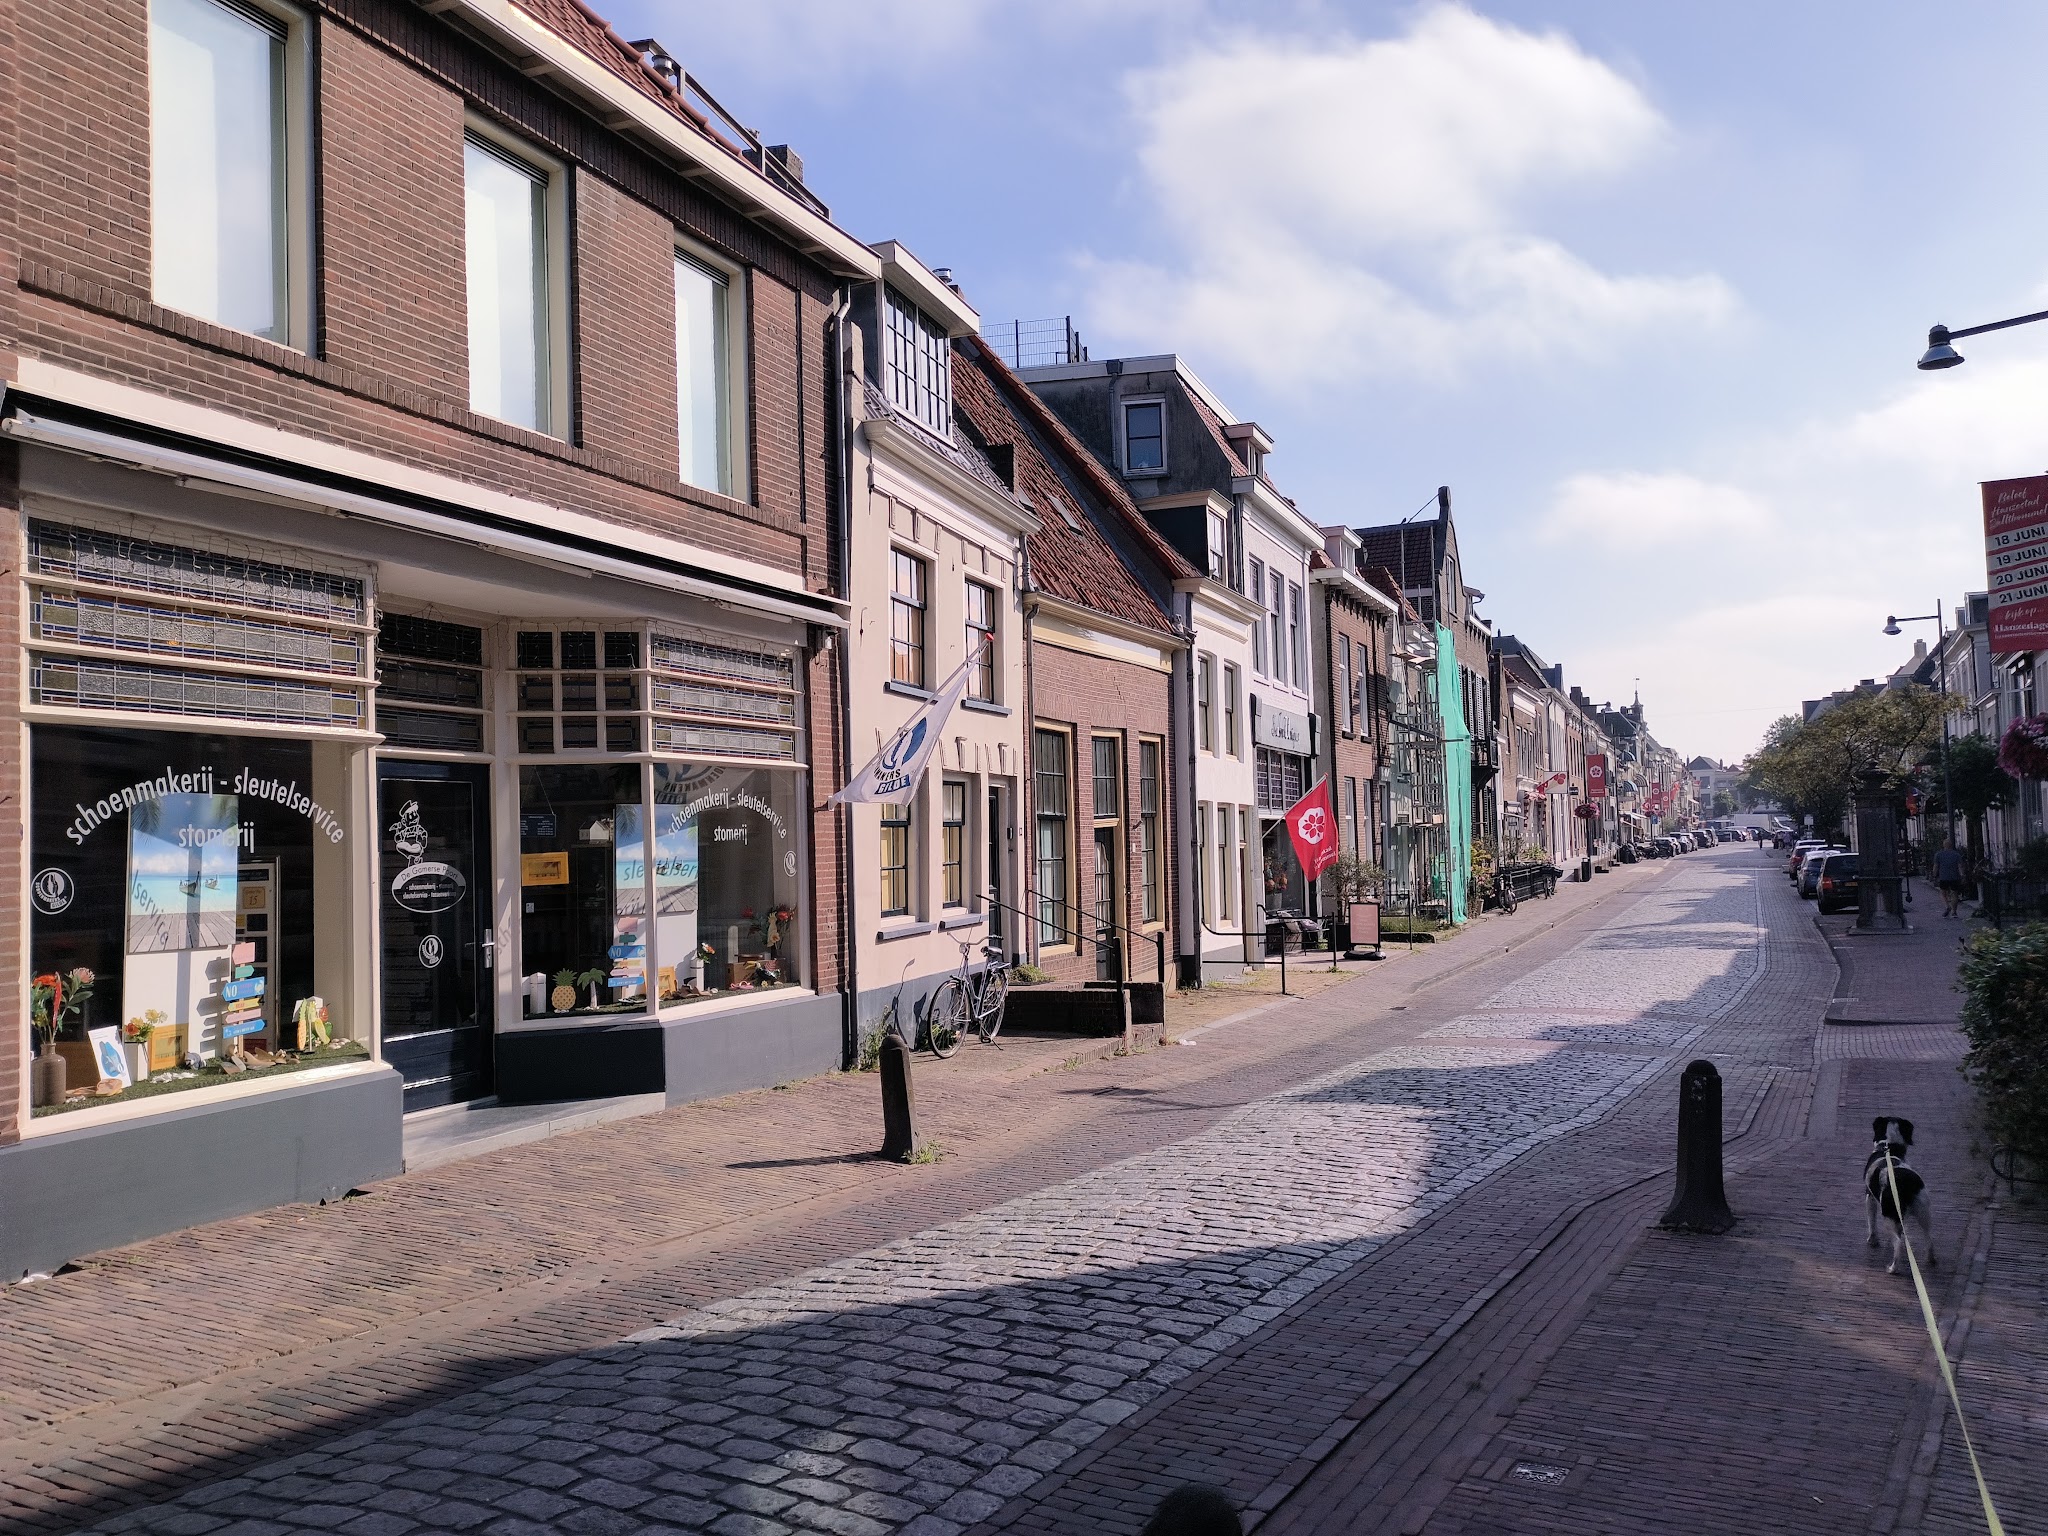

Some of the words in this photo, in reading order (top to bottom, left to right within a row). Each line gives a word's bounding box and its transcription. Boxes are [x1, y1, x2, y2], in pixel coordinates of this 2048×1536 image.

[1995, 534, 2010, 546] 18
[2013, 526, 2046, 542] JUNI
[1997, 554, 2011, 566] 19
[2014, 546, 2047, 562] JUNI
[1996, 573, 2013, 586] 20
[2017, 564, 2048, 581] JUNI
[1999, 592, 2013, 604] 21
[2016, 584, 2048, 600] JUNI
[878, 776, 907, 793] GILDE
[66, 766, 213, 846] schoenmakerij
[234, 766, 344, 844] sleutelservice
[668, 788, 729, 839] schoenmakerij
[178, 822, 255, 853] stomerij
[713, 824, 748, 845] stomerij
[401, 873, 411, 881] De
[412, 865, 440, 875] Gamerse
[611, 947, 621, 958] NO
[226, 984, 238, 997] NO
